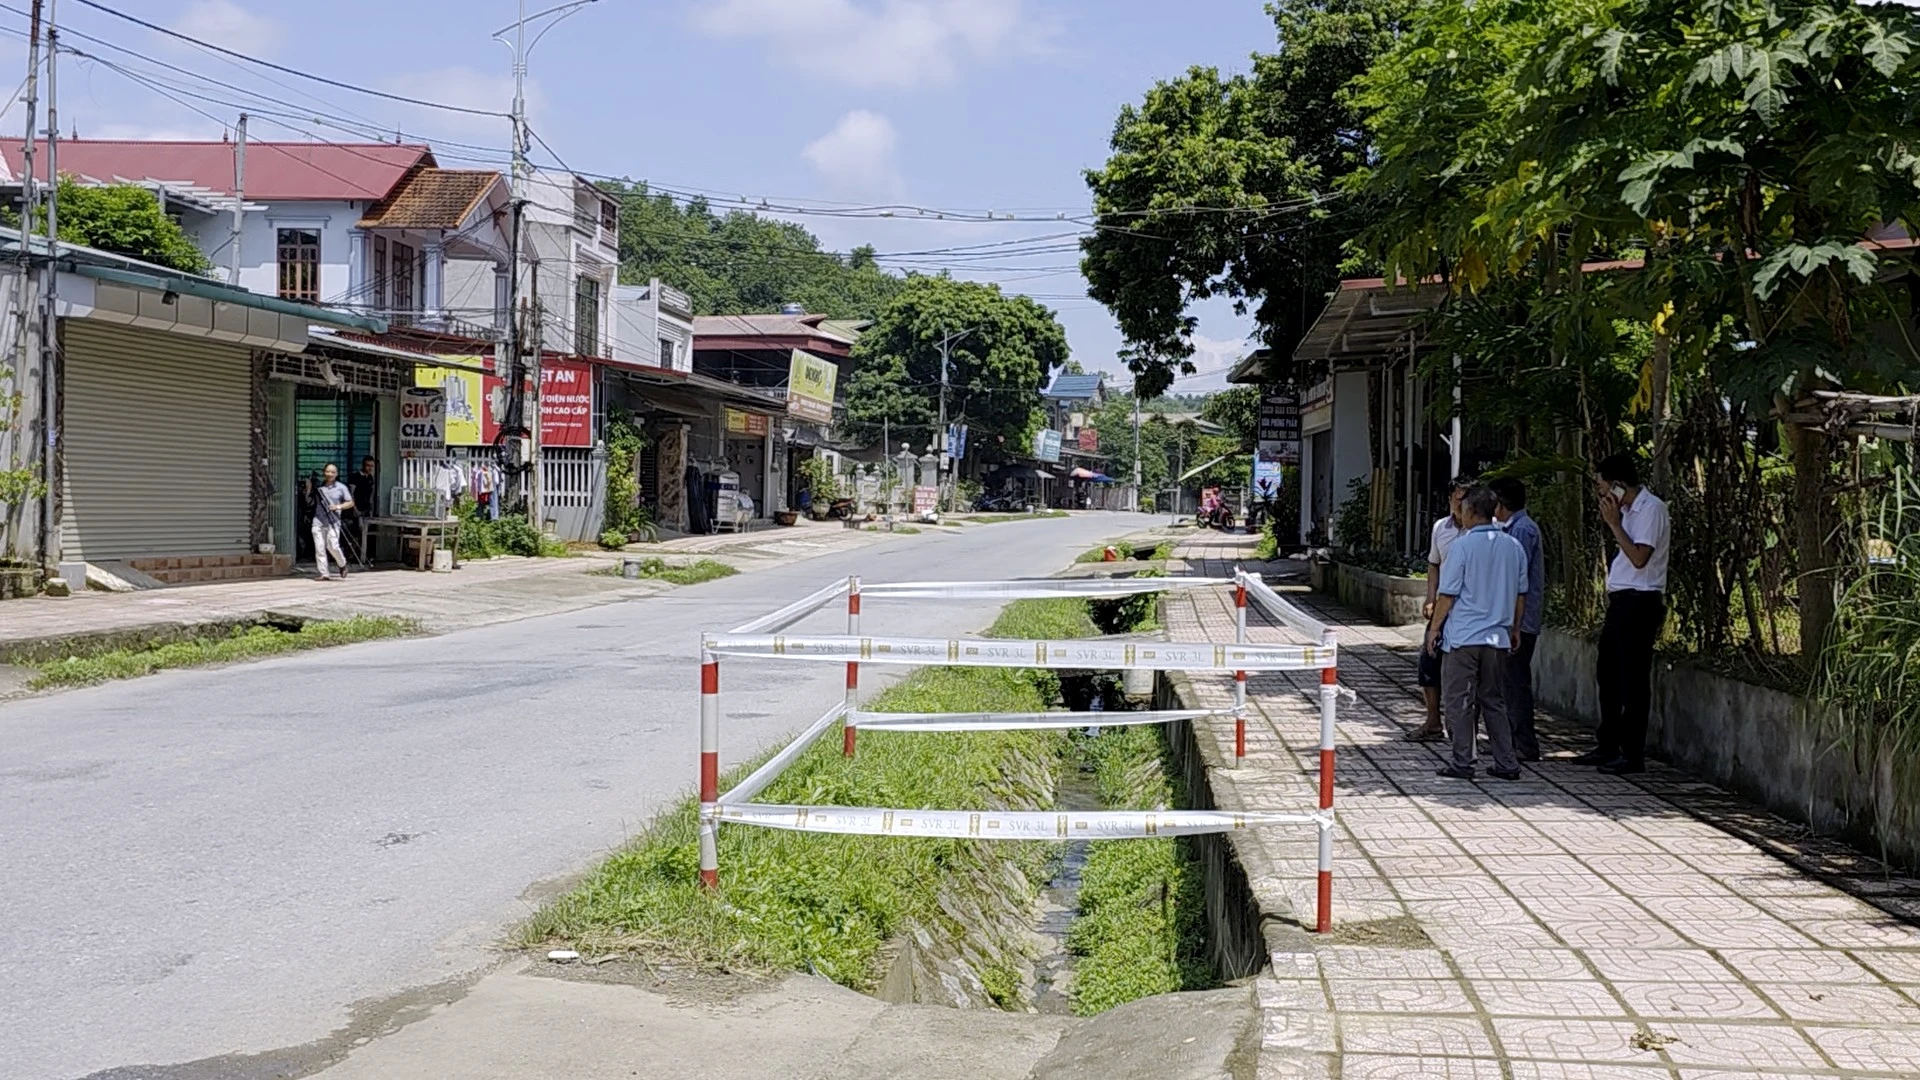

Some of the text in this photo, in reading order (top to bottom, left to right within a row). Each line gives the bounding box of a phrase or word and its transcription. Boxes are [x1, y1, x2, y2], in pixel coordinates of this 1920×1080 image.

[555, 370, 575, 383] AN
[402, 419, 439, 438] CHẢ
[813, 643, 834, 654] SVR
[900, 645, 939, 656] SVR 3L
[987, 647, 1026, 658] SVR 3L
[1076, 649, 1115, 660] SVR 3L
[1165, 651, 1205, 662] SVR 3L
[835, 815, 873, 826] SVR 3L
[921, 818, 959, 830] SVR 3L
[1008, 819, 1048, 831] SVR 3L
[1097, 819, 1136, 831] SVR 3L
